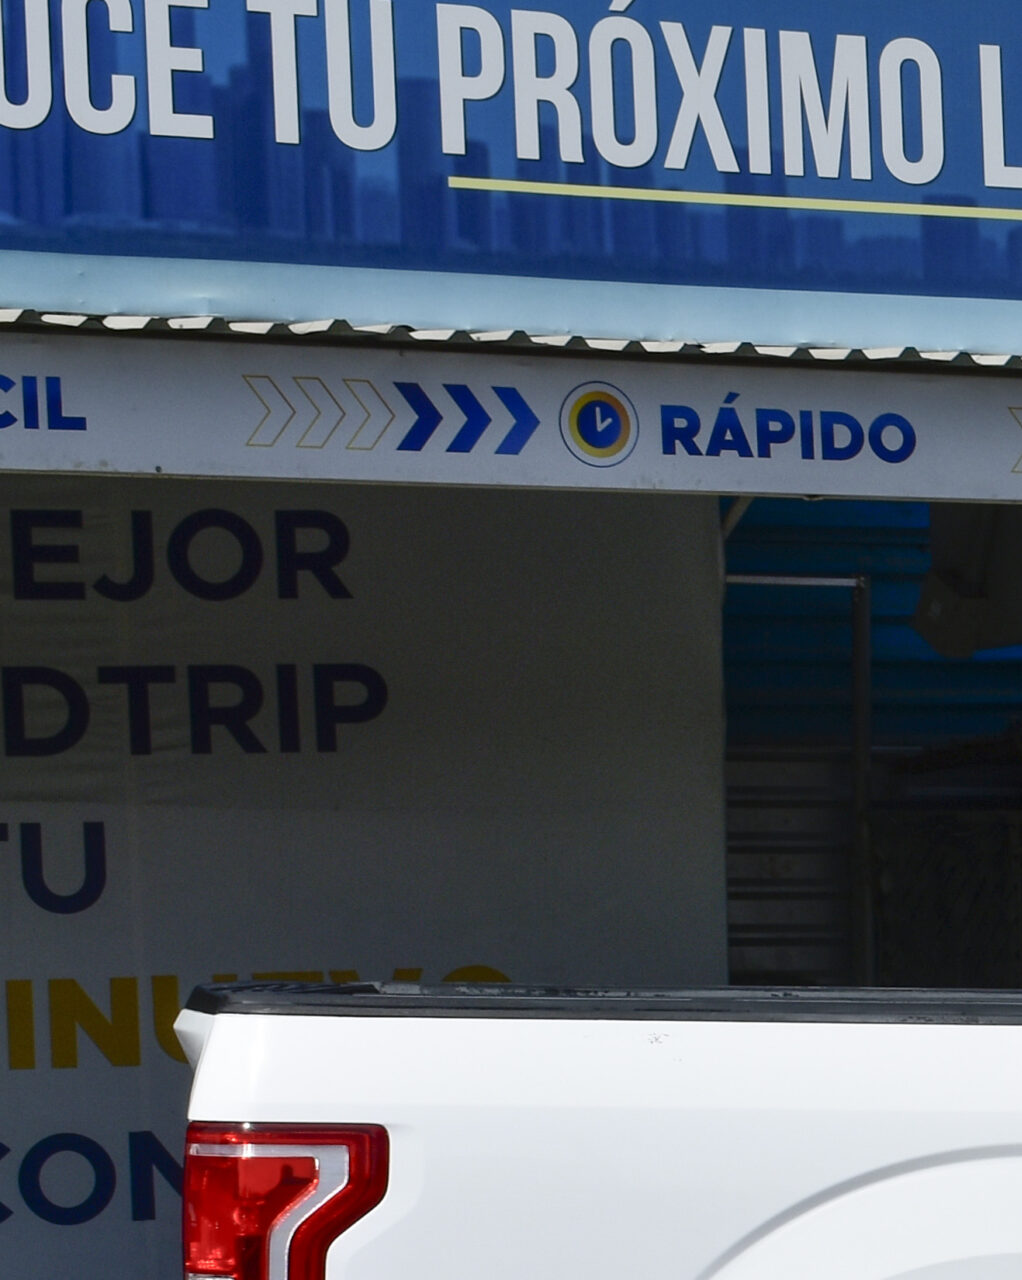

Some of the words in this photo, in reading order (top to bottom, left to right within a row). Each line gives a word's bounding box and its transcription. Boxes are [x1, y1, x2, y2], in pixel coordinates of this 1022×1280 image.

[246, 0, 398, 151] TU
[436, 0, 944, 185] PRÓXIMO
[661, 392, 917, 464] RÁPIDO
[10, 508, 354, 601] EJOR
[2, 663, 389, 758] DTRIP
